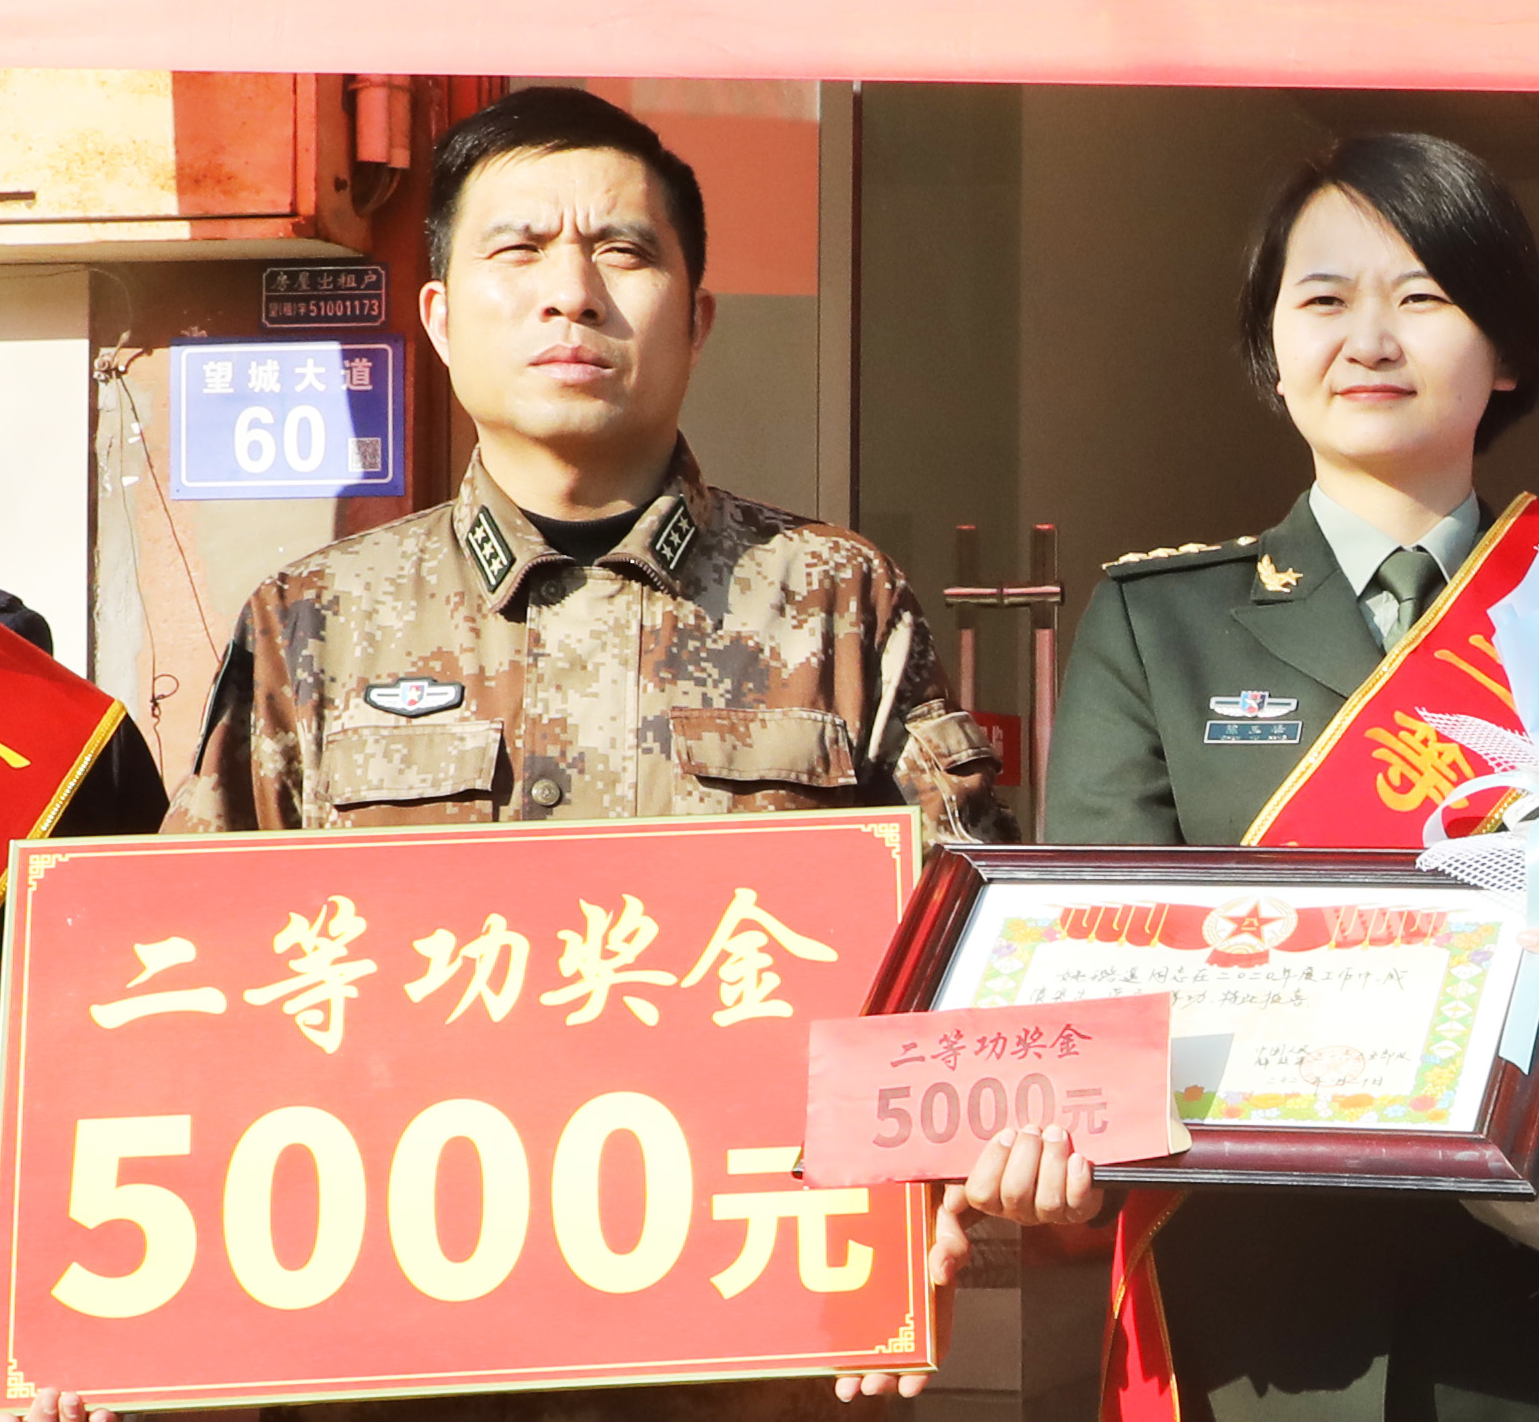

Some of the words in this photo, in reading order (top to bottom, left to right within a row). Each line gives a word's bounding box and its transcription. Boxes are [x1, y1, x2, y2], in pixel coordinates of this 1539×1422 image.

[202, 358, 373, 394] 望城大道
[234, 404, 327, 474] 60
[89, 887, 839, 1054] 二等功奖金
[889, 1023, 1093, 1071] 二等功奖金
[871, 1072, 1110, 1149] 5000元
[50, 1091, 874, 1319] 5000元
